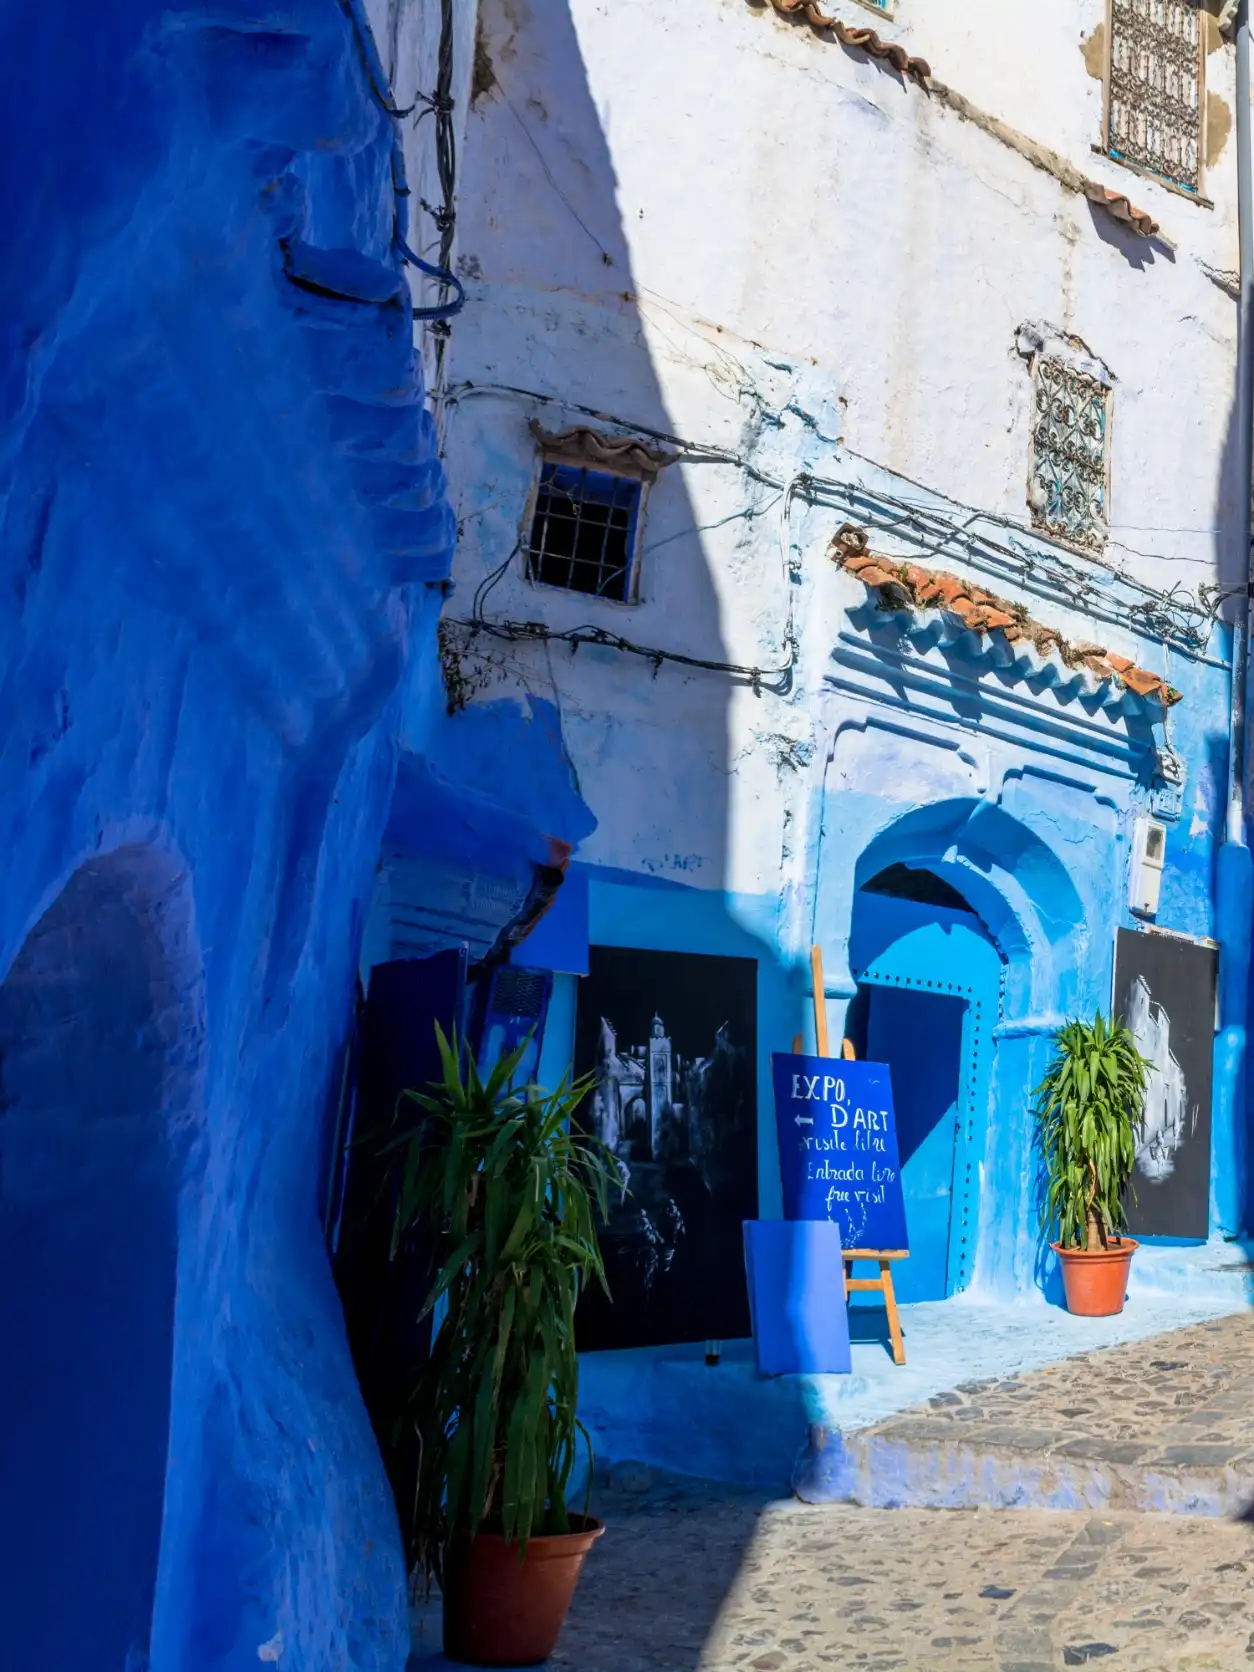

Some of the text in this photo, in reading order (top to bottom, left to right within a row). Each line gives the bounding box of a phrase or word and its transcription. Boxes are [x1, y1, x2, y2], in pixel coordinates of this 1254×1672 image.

[791, 1073, 845, 1102] EXPO
[830, 1099, 888, 1131] D'ART
[808, 1160, 864, 1180] Entrada
[825, 1186, 850, 1212] free
